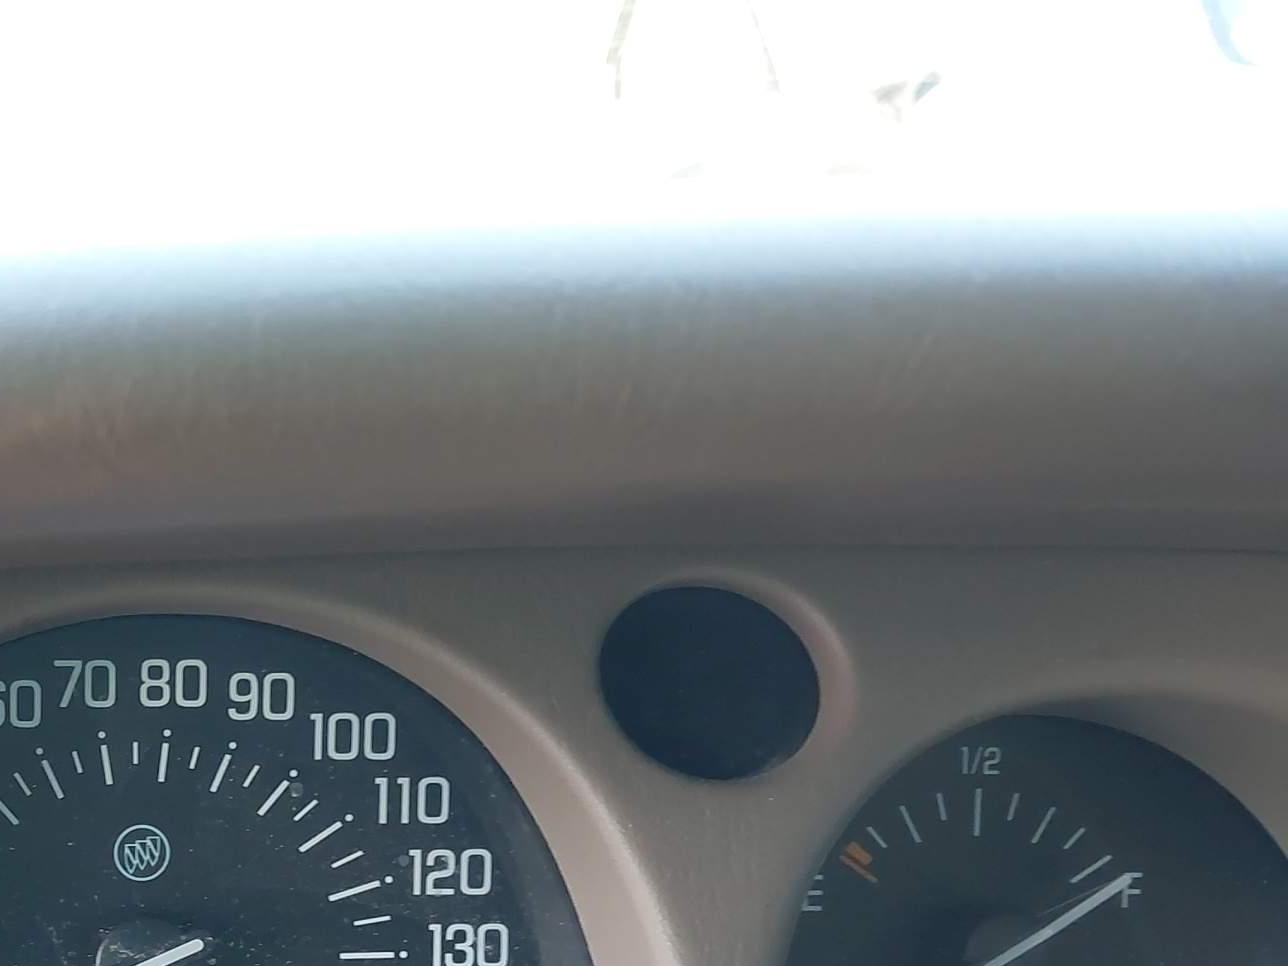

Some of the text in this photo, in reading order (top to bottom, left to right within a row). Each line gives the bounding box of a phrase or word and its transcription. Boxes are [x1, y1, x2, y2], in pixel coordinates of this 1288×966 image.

[54, 660, 115, 707] 70
[140, 659, 207, 707] 80
[228, 673, 294, 720] 90
[310, 713, 395, 760] 100
[960, 747, 1000, 774] 1/2
[375, 777, 449, 824] 110
[409, 849, 491, 895] 120
